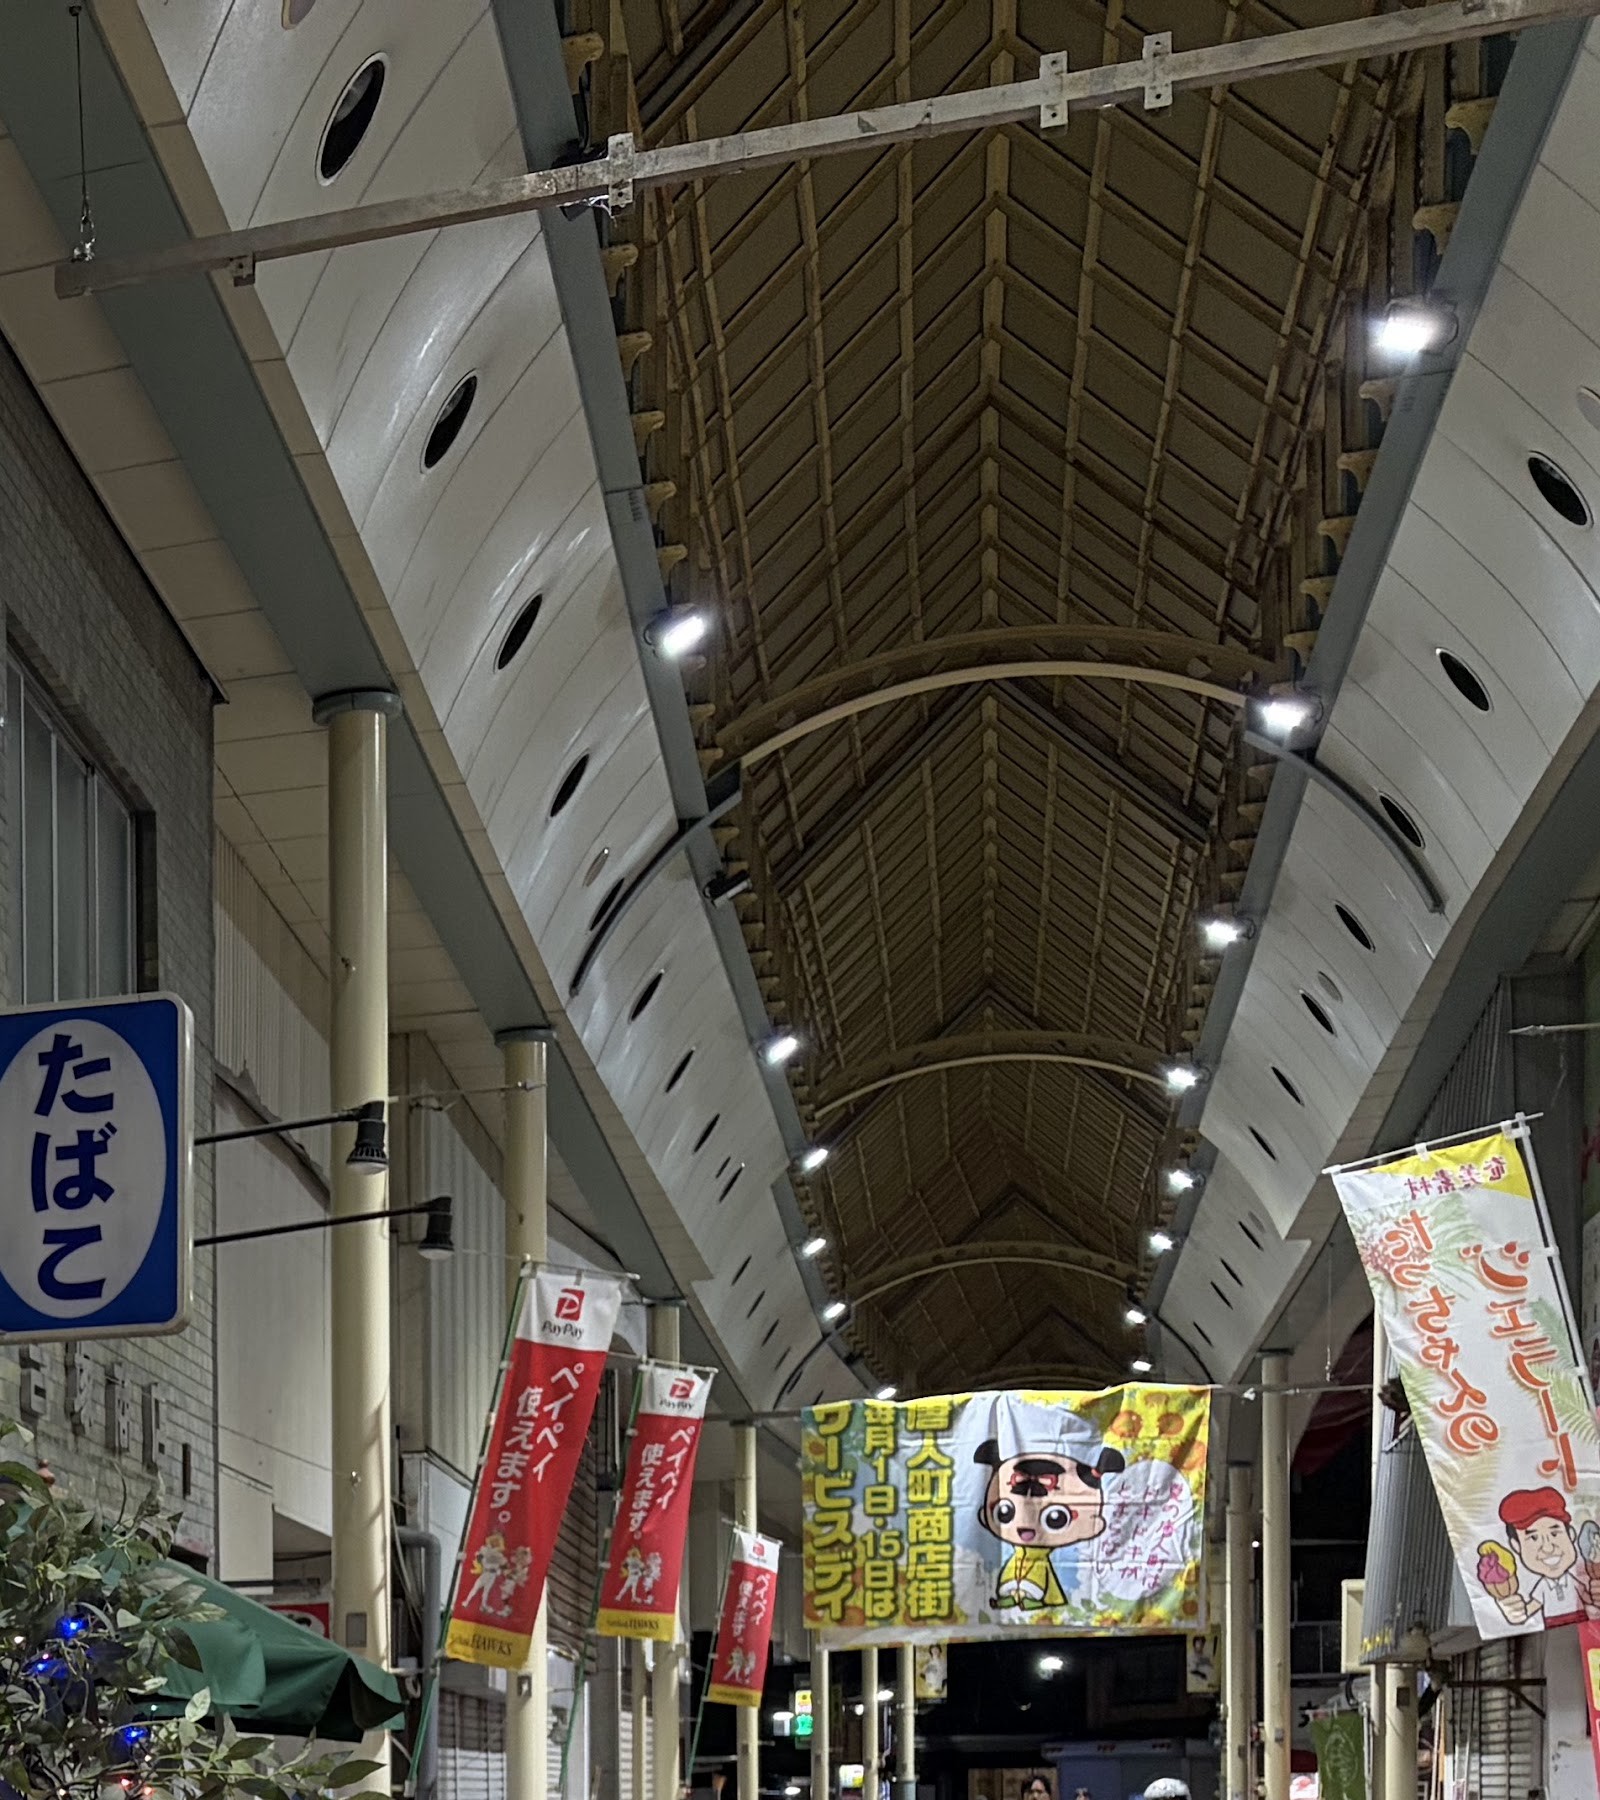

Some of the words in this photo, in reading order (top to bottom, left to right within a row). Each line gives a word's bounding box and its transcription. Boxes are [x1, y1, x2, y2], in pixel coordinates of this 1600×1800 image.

[30, 1034, 116, 1300] たばこ
[541, 1320, 585, 1340] PayPay
[533, 1362, 585, 1483] ペイペイ
[906, 1402, 953, 1619] 唐人町商店街
